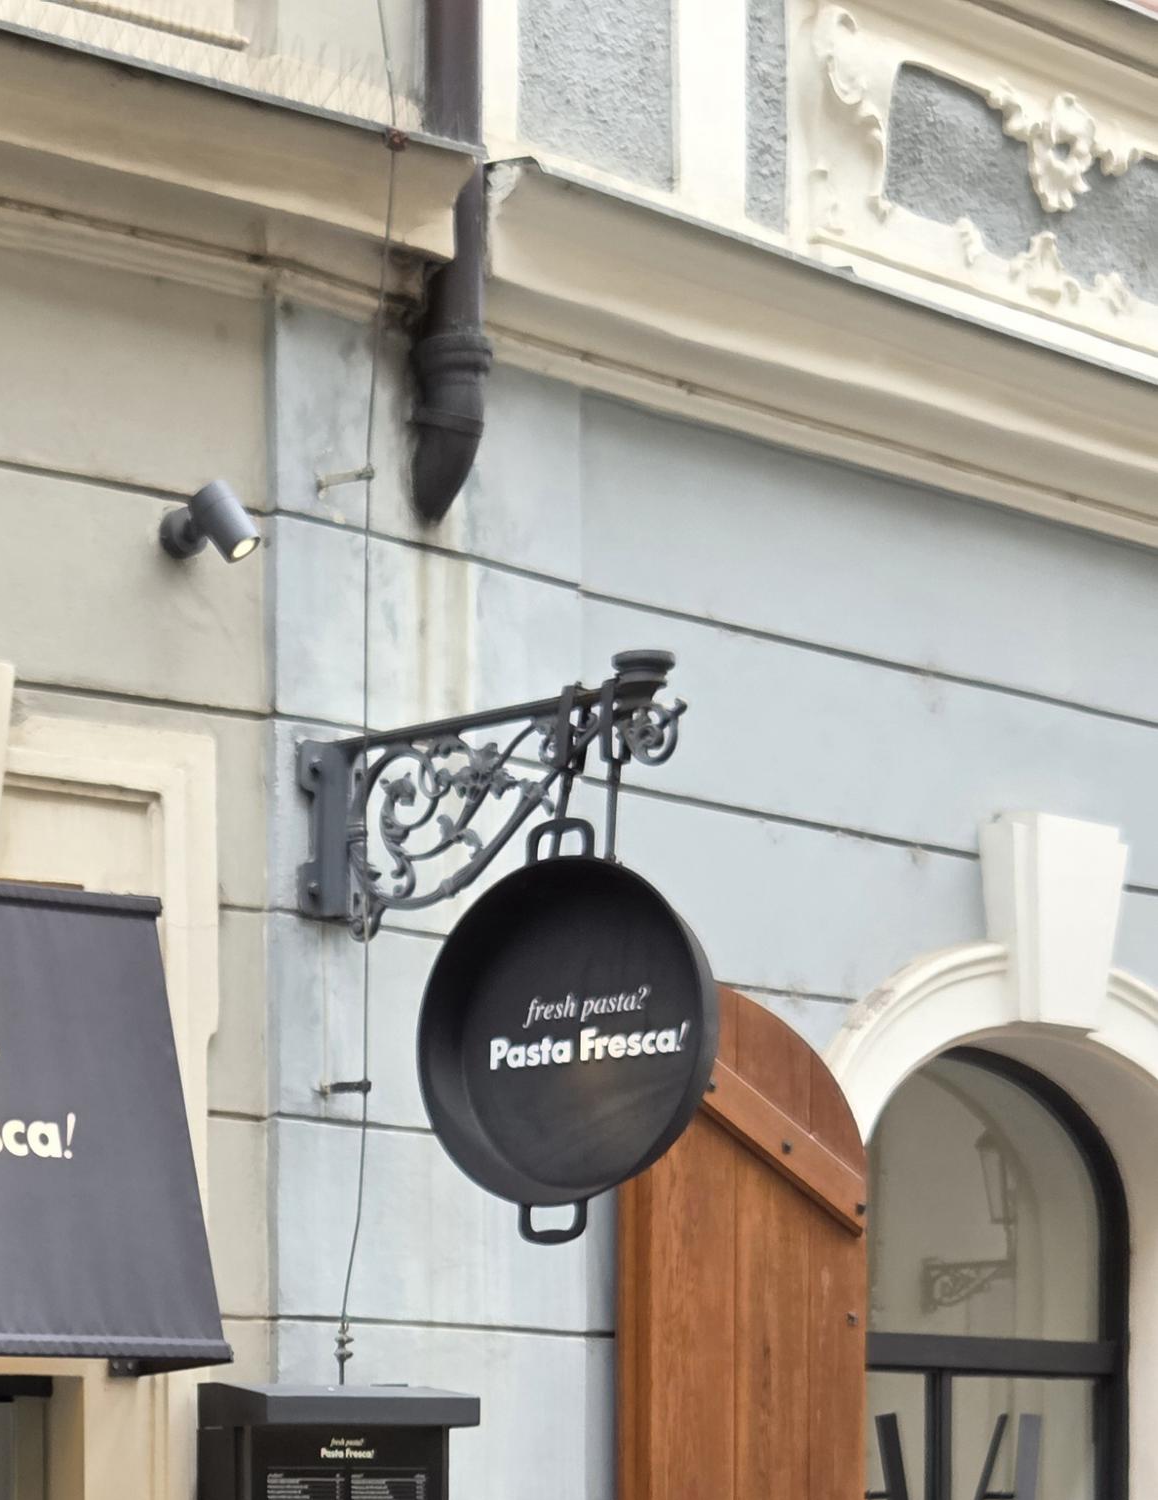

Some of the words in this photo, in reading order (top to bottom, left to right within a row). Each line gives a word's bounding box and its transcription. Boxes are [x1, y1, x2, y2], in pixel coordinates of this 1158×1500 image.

[522, 992, 576, 1029] fresh
[580, 985, 651, 1023] pasta?
[489, 1036, 573, 1071] Pasta
[579, 1019, 690, 1062] Fresca!
